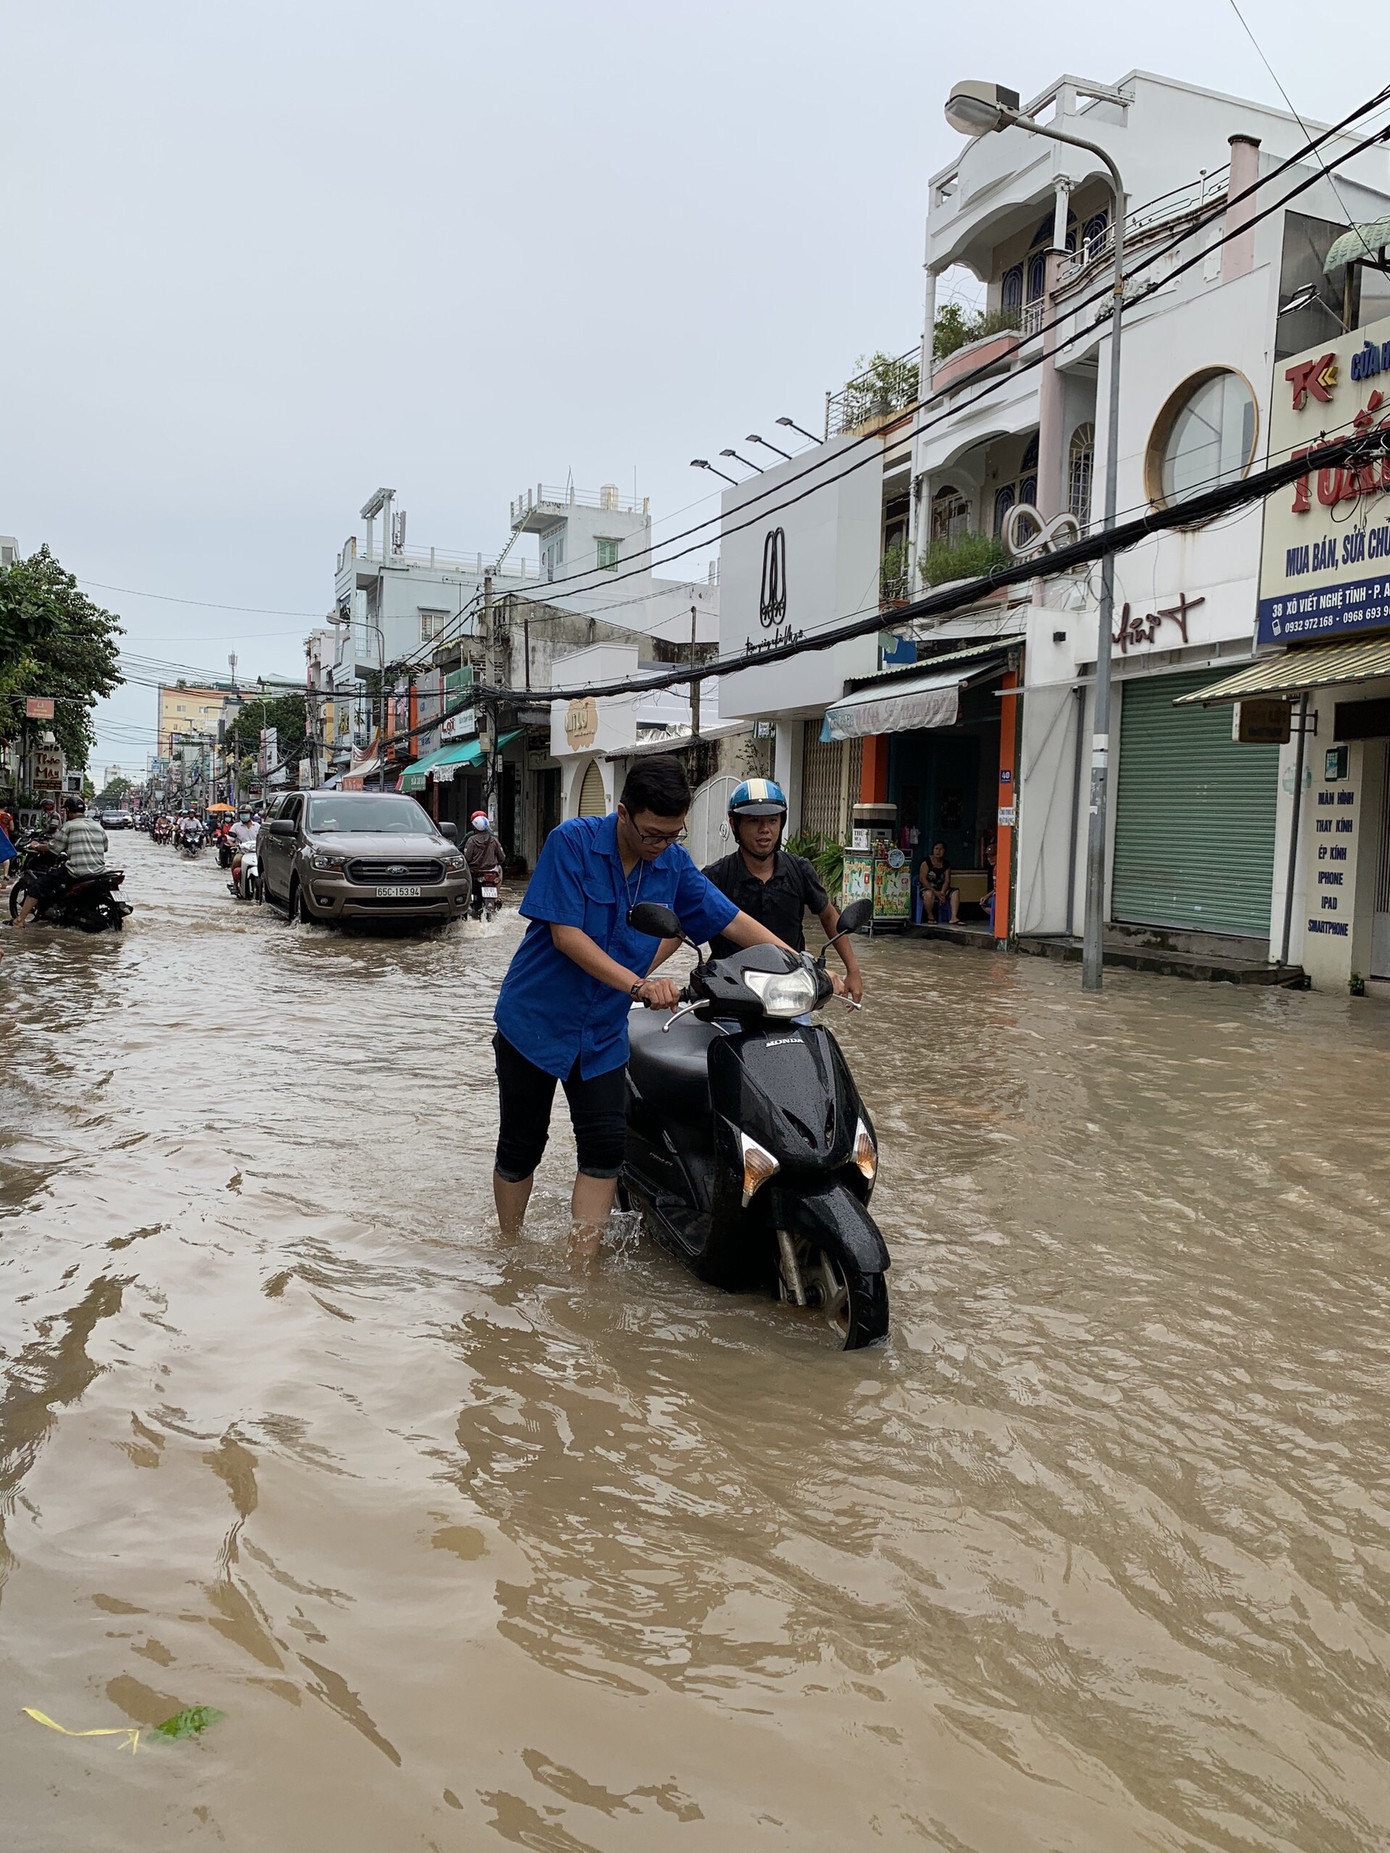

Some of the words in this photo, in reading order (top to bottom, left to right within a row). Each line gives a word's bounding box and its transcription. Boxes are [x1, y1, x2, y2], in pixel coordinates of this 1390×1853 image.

[1285, 353, 1336, 411] TK
[1285, 545, 1310, 578] MUA
[1312, 534, 1339, 571] BÁN,
[1341, 524, 1367, 566] SỬA
[1272, 603, 1283, 618] 38
[1286, 597, 1298, 615] XÔ
[1299, 593, 1318, 613] VIẾT
[1319, 588, 1343, 610] NGHỆ
[1345, 586, 1367, 604] TĨNH
[1373, 585, 1382, 599] P.
[1285, 621, 1303, 633] 0932
[1304, 618, 1318, 630] 972
[1319, 615, 1334, 628] 168
[1343, 610, 1364, 623] 0968
[1365, 607, 1382, 619] 693
[1316, 819, 1332, 833] THAY
[1335, 817, 1353, 833] KÍNH
[1318, 844, 1327, 860] ÉP
[1329, 844, 1347, 860] KÍNH
[1318, 871, 1343, 885] IPHONE
[1321, 895, 1338, 910] IPAD
[1308, 919, 1349, 937] SMARTPHONE
